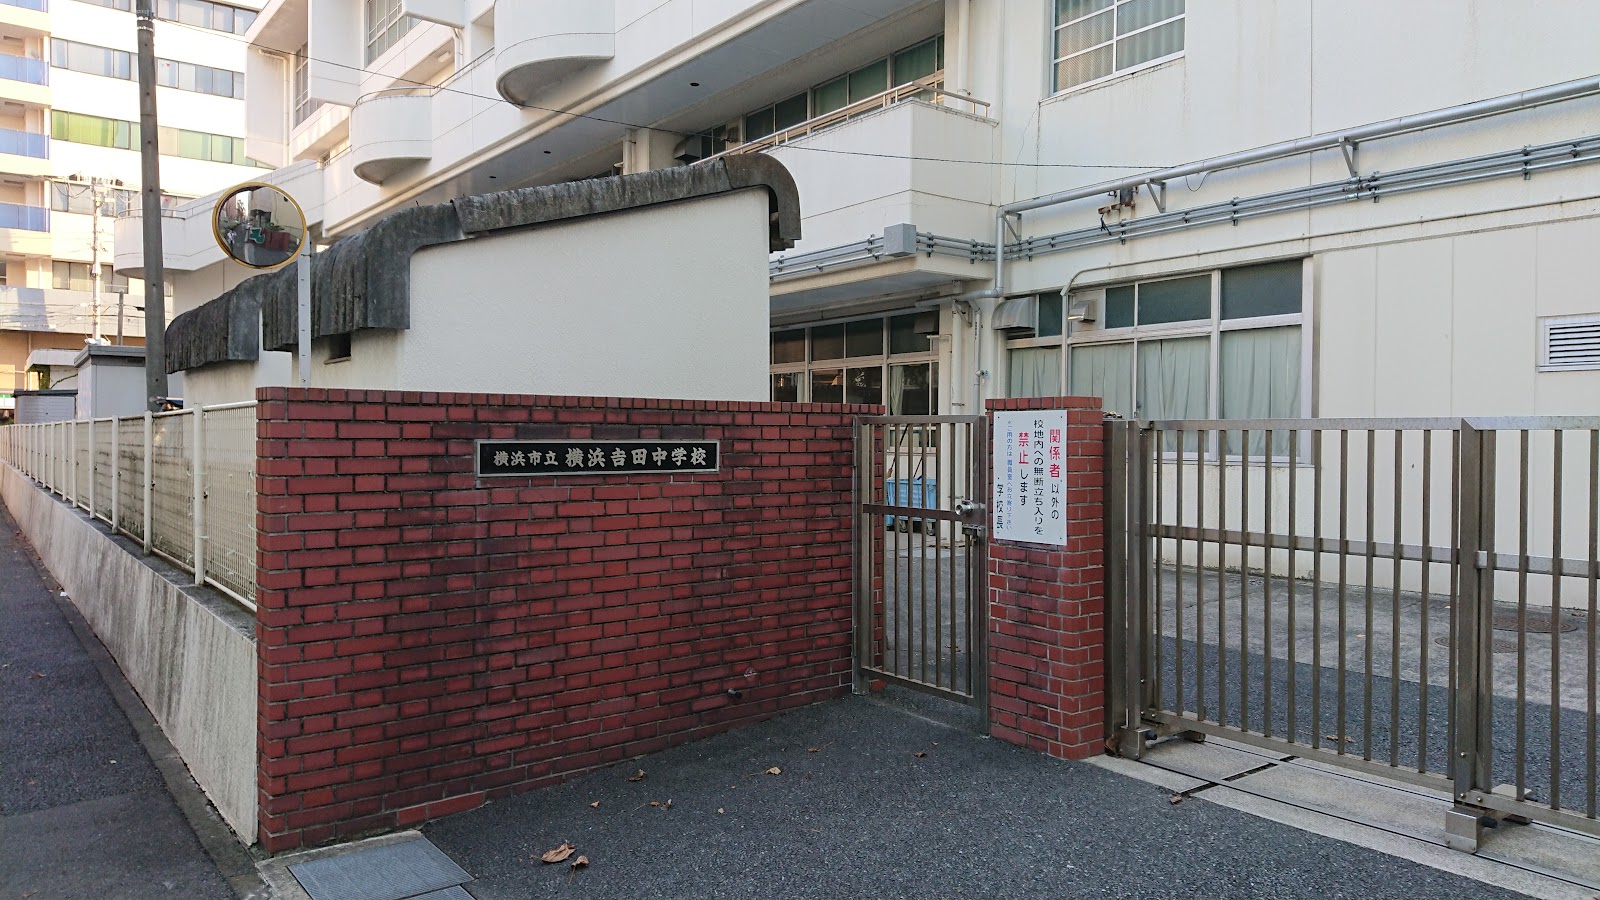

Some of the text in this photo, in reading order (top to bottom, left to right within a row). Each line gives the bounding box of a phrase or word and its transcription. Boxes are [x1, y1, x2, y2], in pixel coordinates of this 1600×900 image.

[493, 450, 559, 467] 横浜市立
[1018, 432, 1029, 506] 禁止します
